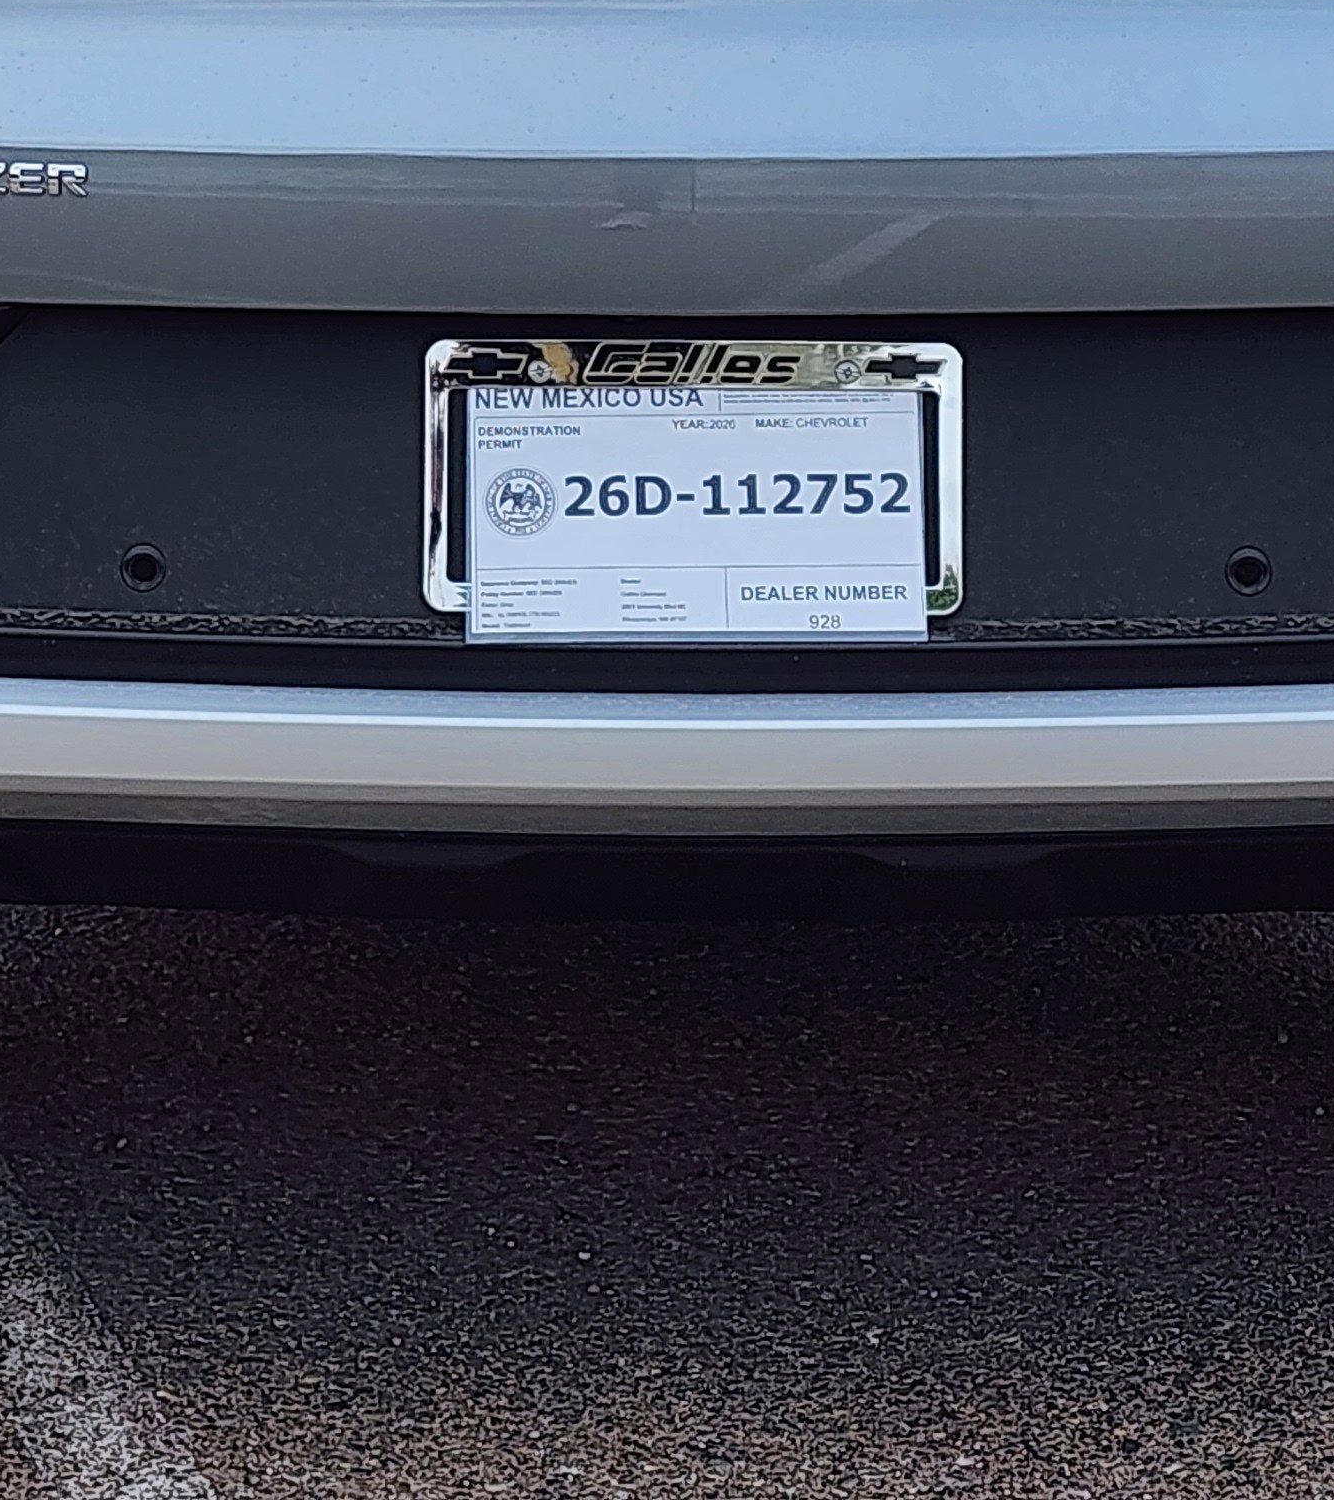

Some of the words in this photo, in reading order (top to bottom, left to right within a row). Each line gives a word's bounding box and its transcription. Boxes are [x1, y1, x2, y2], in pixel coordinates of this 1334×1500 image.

[582, 342, 802, 385] Galles
[475, 388, 533, 409] NEW
[542, 388, 642, 409] MEXICO
[649, 388, 704, 408] USA
[754, 418, 793, 428] MAKE:
[795, 417, 869, 428] CHEVROLET
[477, 426, 581, 437] DEMONSTRATION
[477, 439, 523, 450] PERMIT
[564, 472, 911, 517] 26D-112752
[740, 585, 819, 601] DEALER
[824, 585, 908, 600] NUMBER
[808, 614, 842, 630] 928
